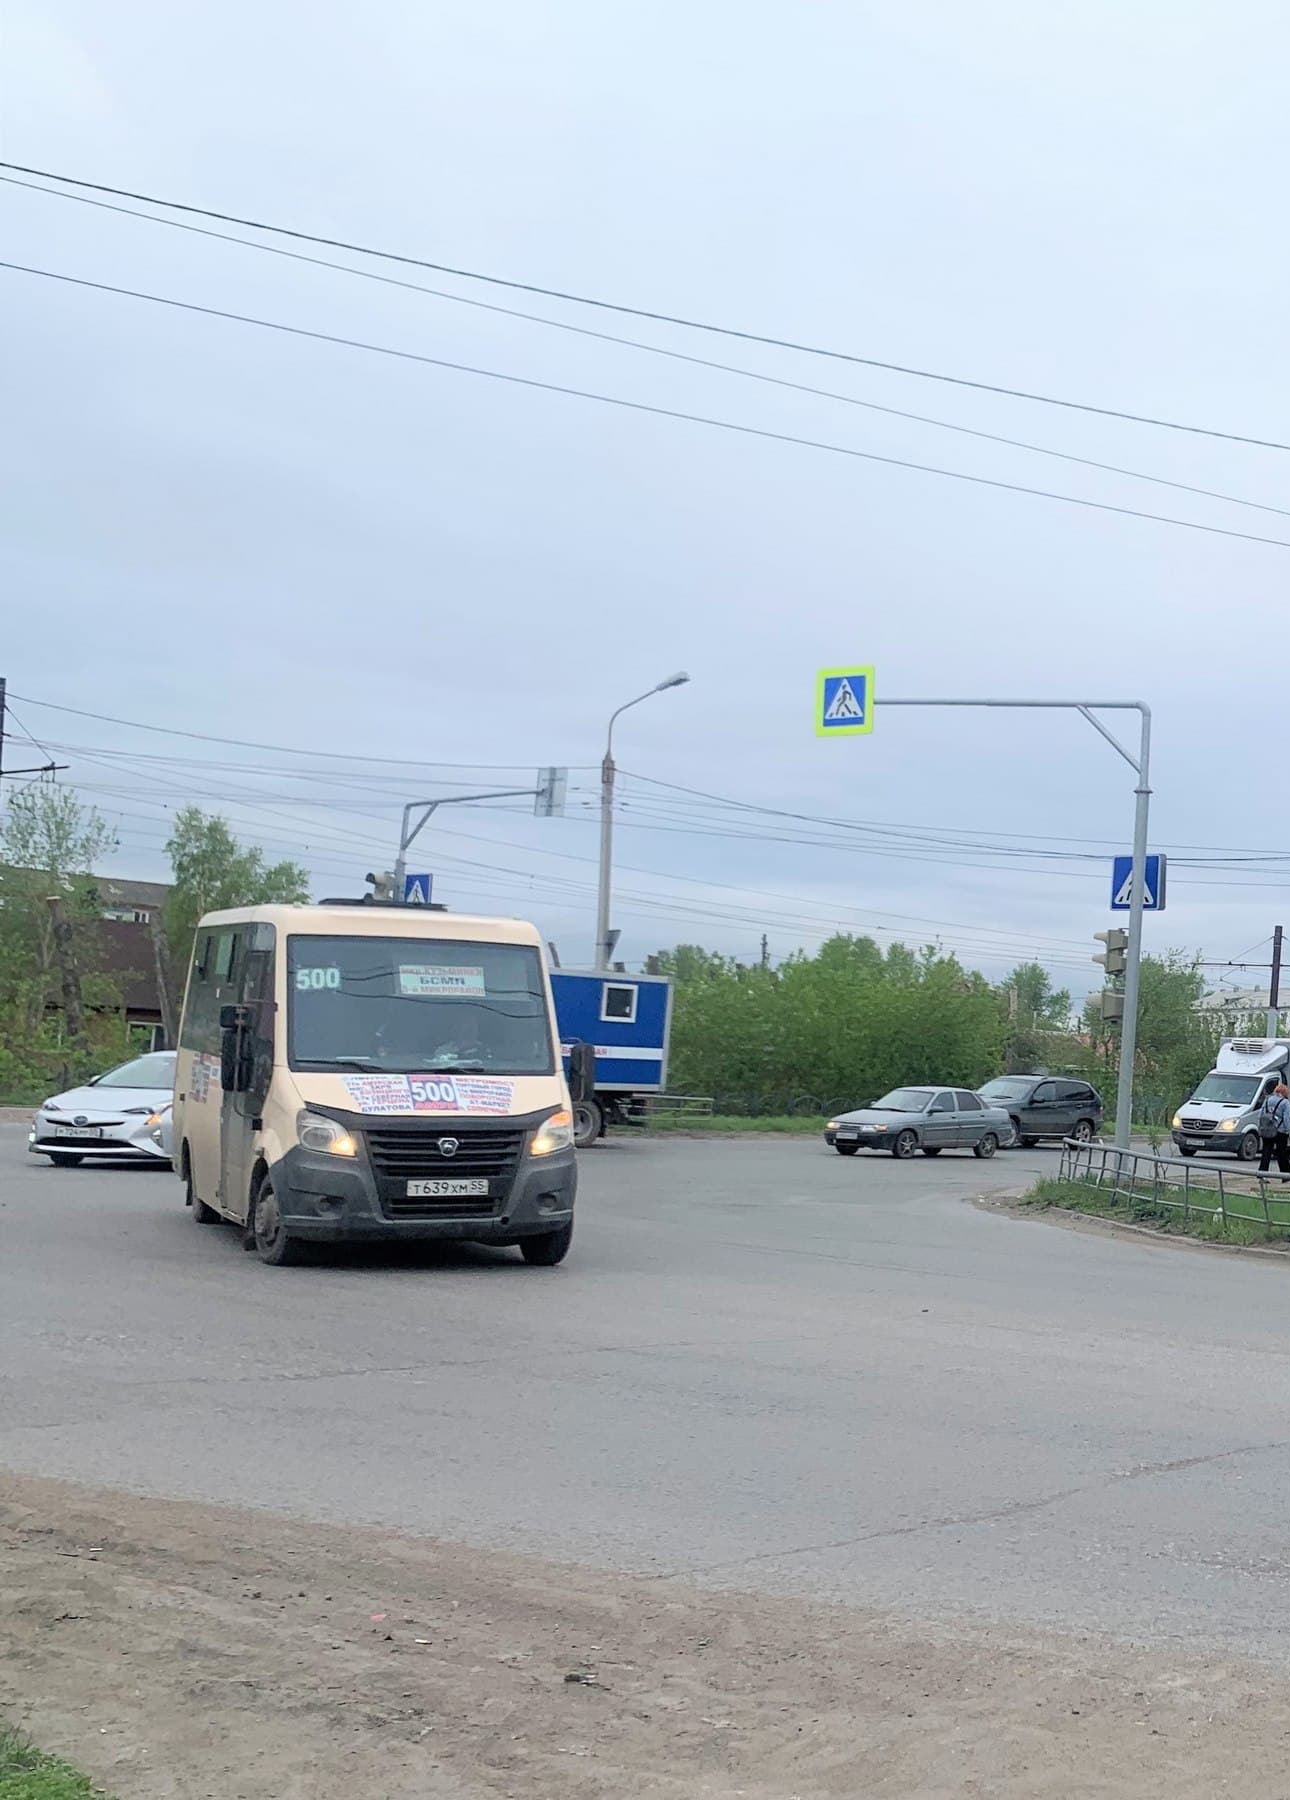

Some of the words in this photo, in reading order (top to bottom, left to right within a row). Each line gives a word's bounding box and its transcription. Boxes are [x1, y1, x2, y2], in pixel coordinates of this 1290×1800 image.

[295, 968, 340, 990] 500
[411, 1081, 454, 1103] 500
[471, 1181, 484, 1190] 55
